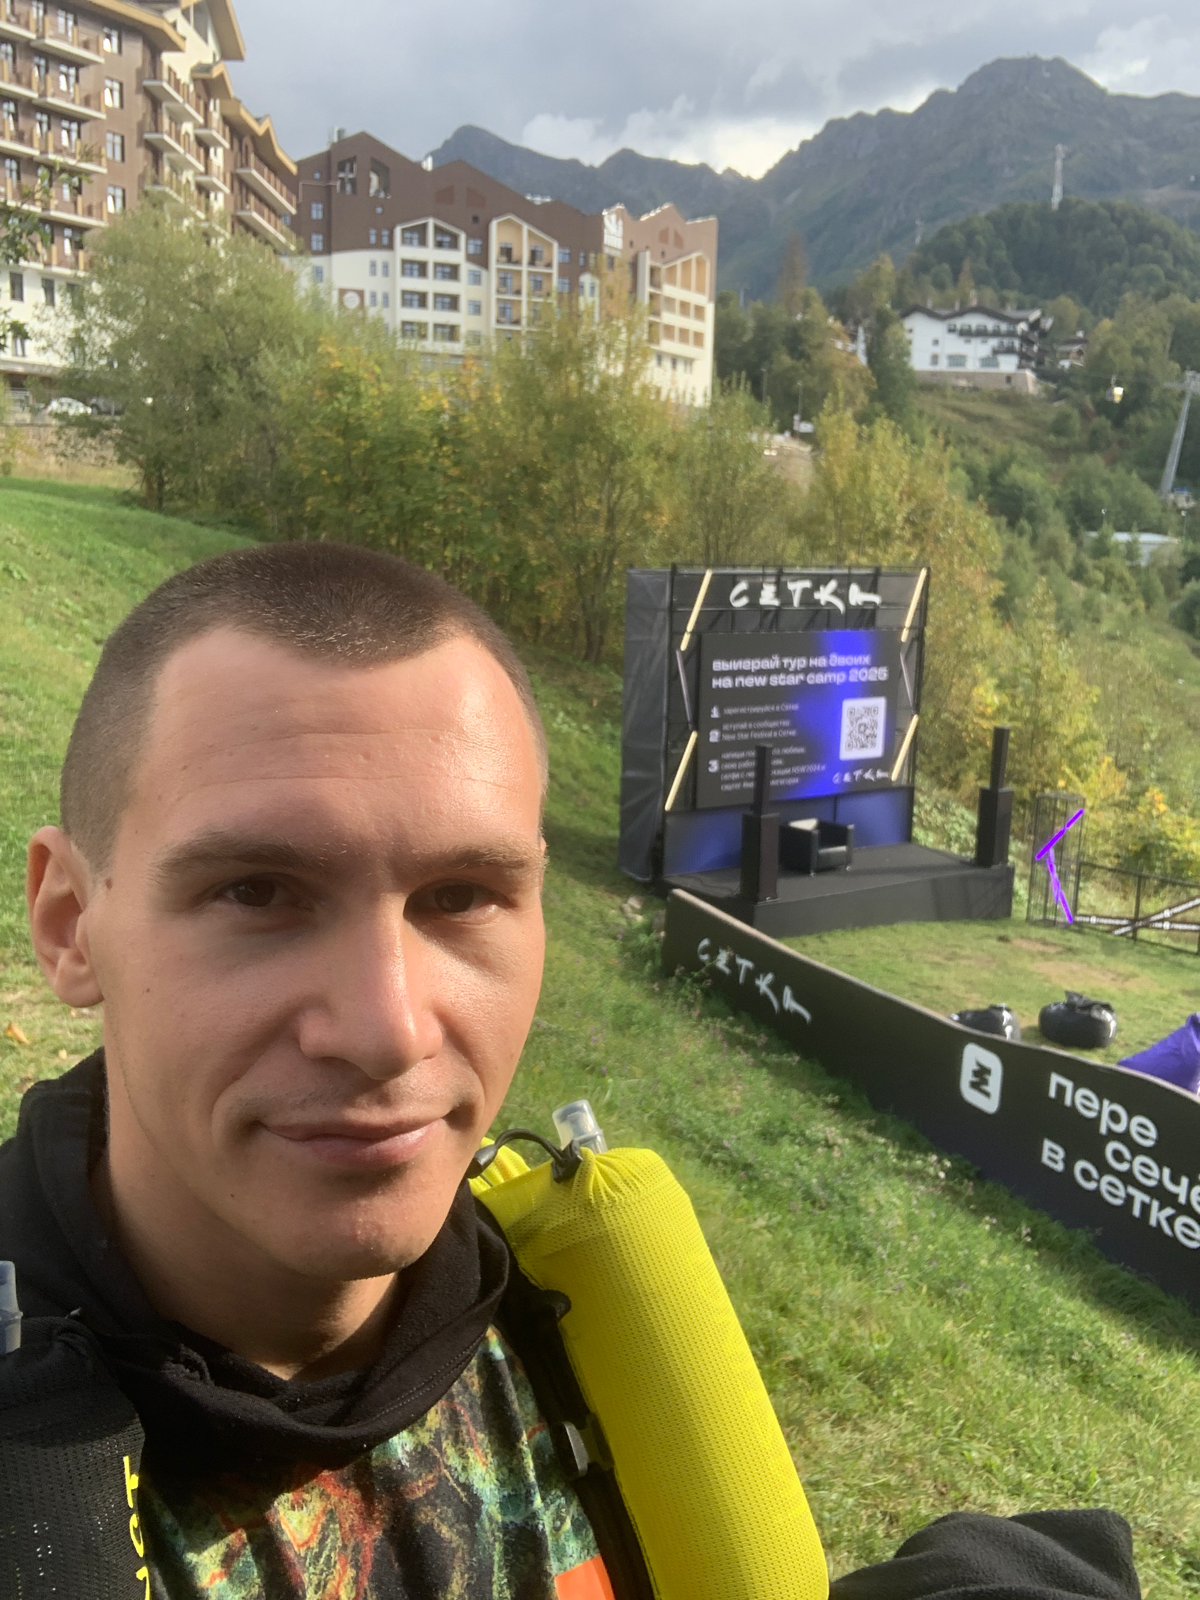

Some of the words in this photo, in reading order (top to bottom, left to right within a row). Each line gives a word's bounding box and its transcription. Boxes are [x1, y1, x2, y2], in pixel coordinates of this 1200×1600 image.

[782, 657, 806, 671] тур
[809, 656, 827, 668] на
[829, 652, 872, 666] двоих
[712, 677, 732, 689] на
[735, 675, 767, 687] new
[769, 673, 804, 686] star
[806, 671, 846, 685] camp
[848, 666, 888, 682] 2025
[709, 729, 720, 742] 2
[708, 759, 719, 772] 3
[1048, 1071, 1159, 1148] пере
[1041, 1137, 1066, 1173] в
[1073, 1159, 1200, 1250] сетке
